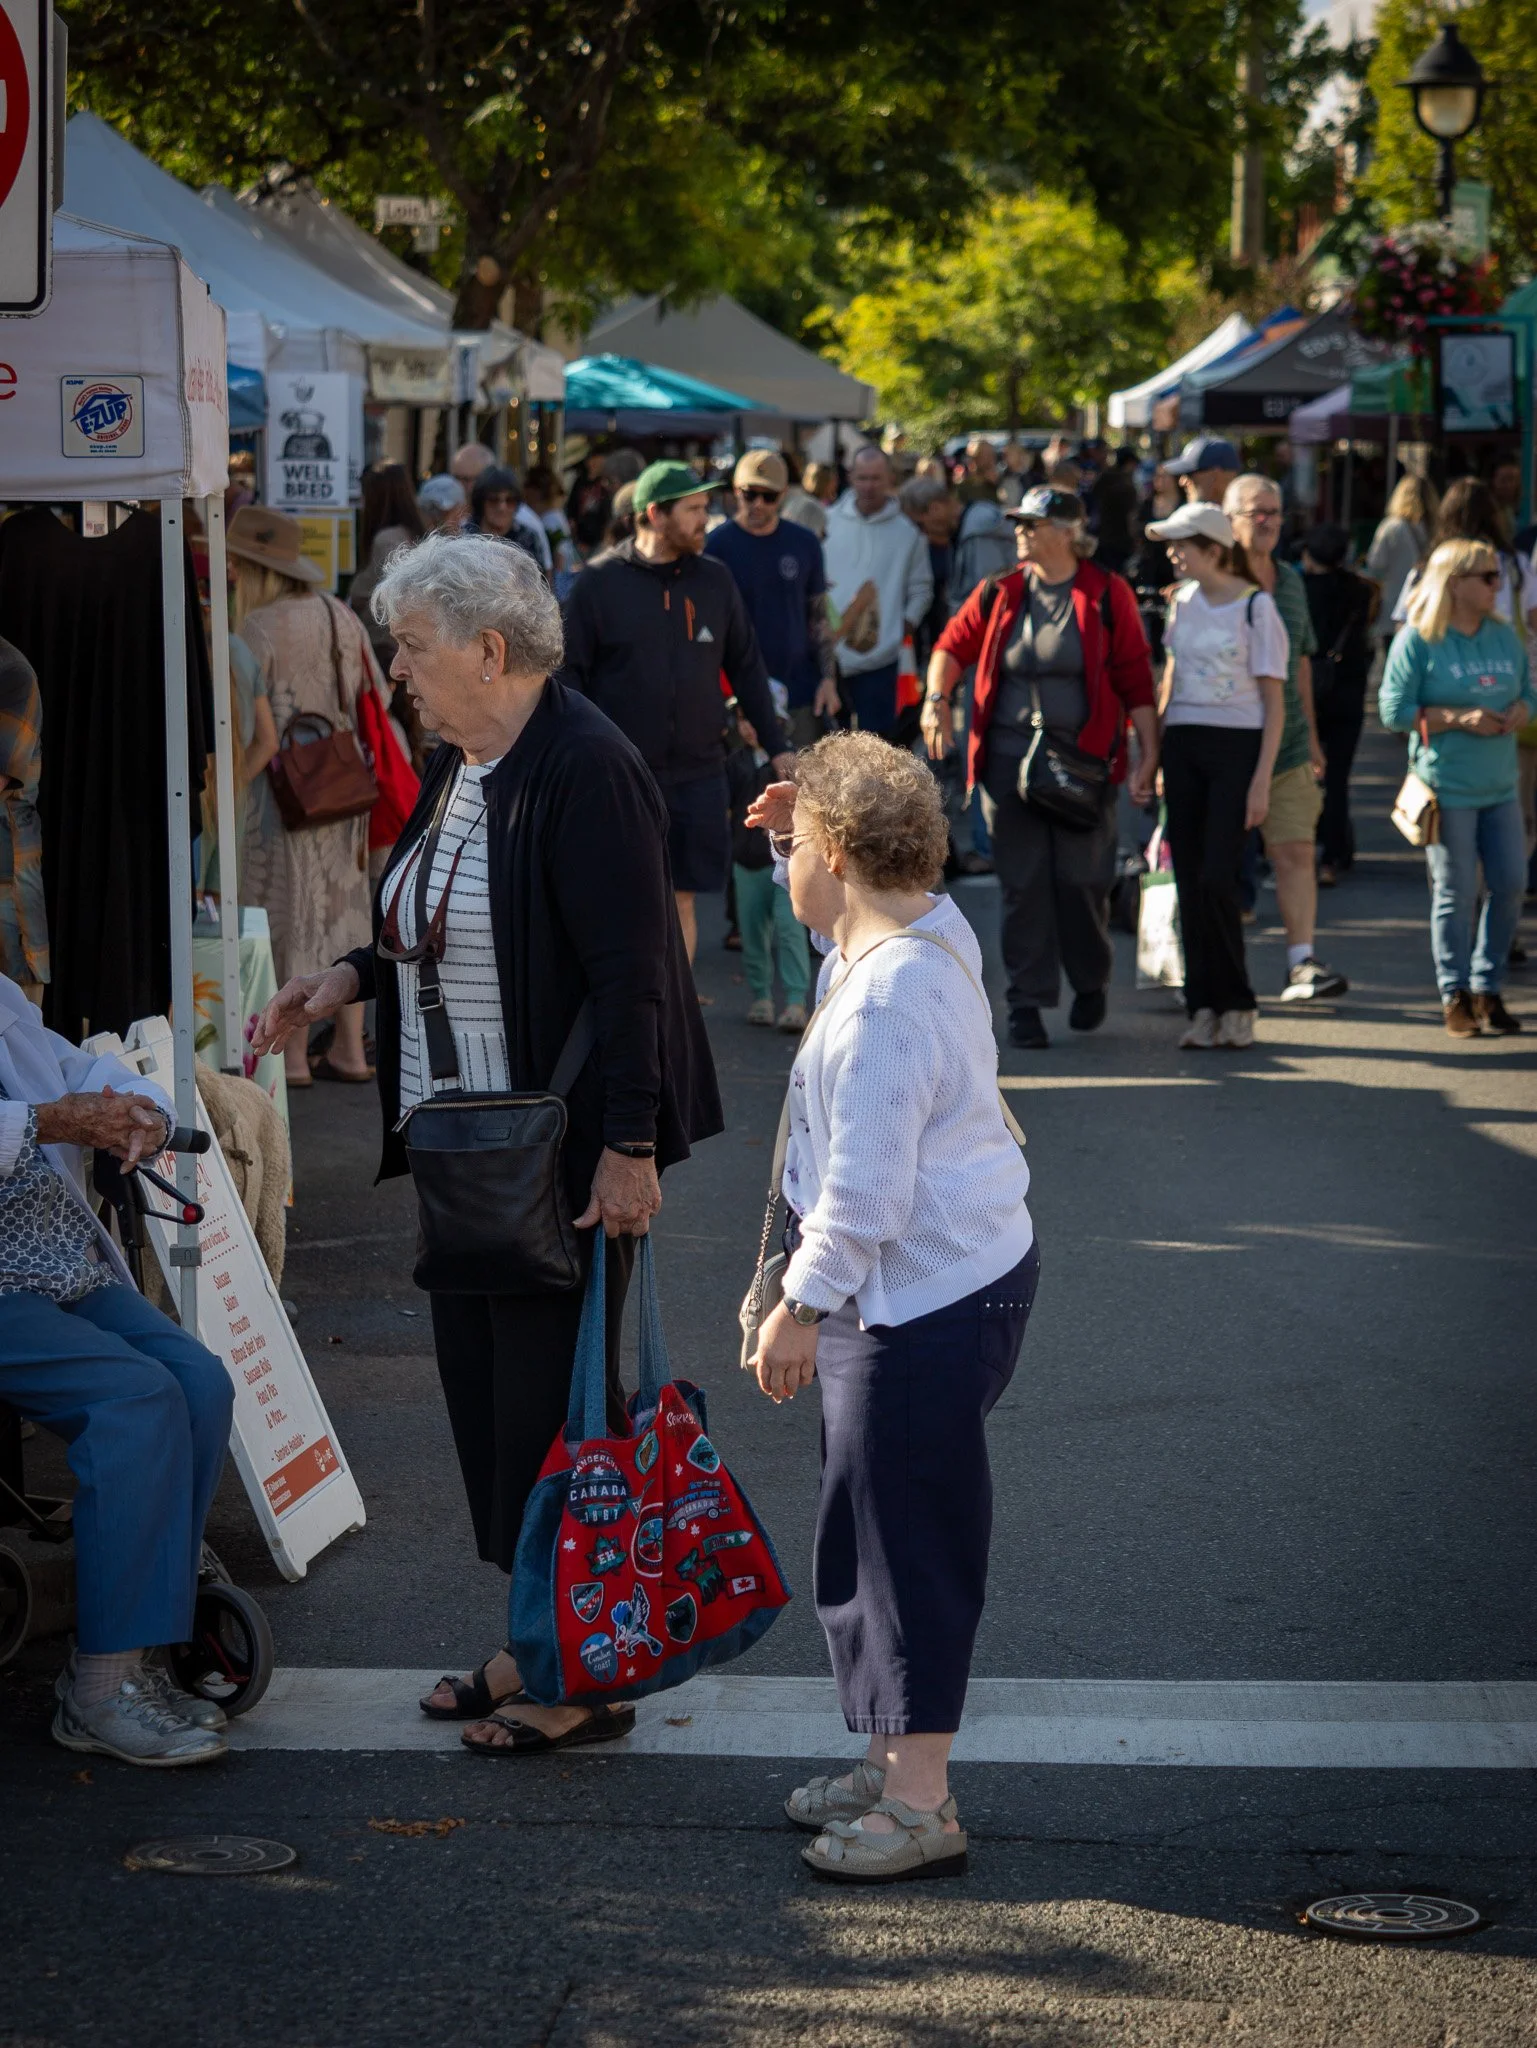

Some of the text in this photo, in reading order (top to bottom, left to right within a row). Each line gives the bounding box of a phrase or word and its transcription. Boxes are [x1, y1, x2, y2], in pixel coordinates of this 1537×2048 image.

[283, 464, 335, 481] WELL
[285, 482, 334, 498] BRED
[213, 1271, 231, 1290] Sausage
[243, 1363, 261, 1385] Sausage
[266, 1382, 278, 1400] Pies
[570, 1485, 627, 1501] CANADA
[685, 1500, 715, 1513] CANADA
[597, 1549, 616, 1565] EH
[593, 1659, 611, 1671] COAST
